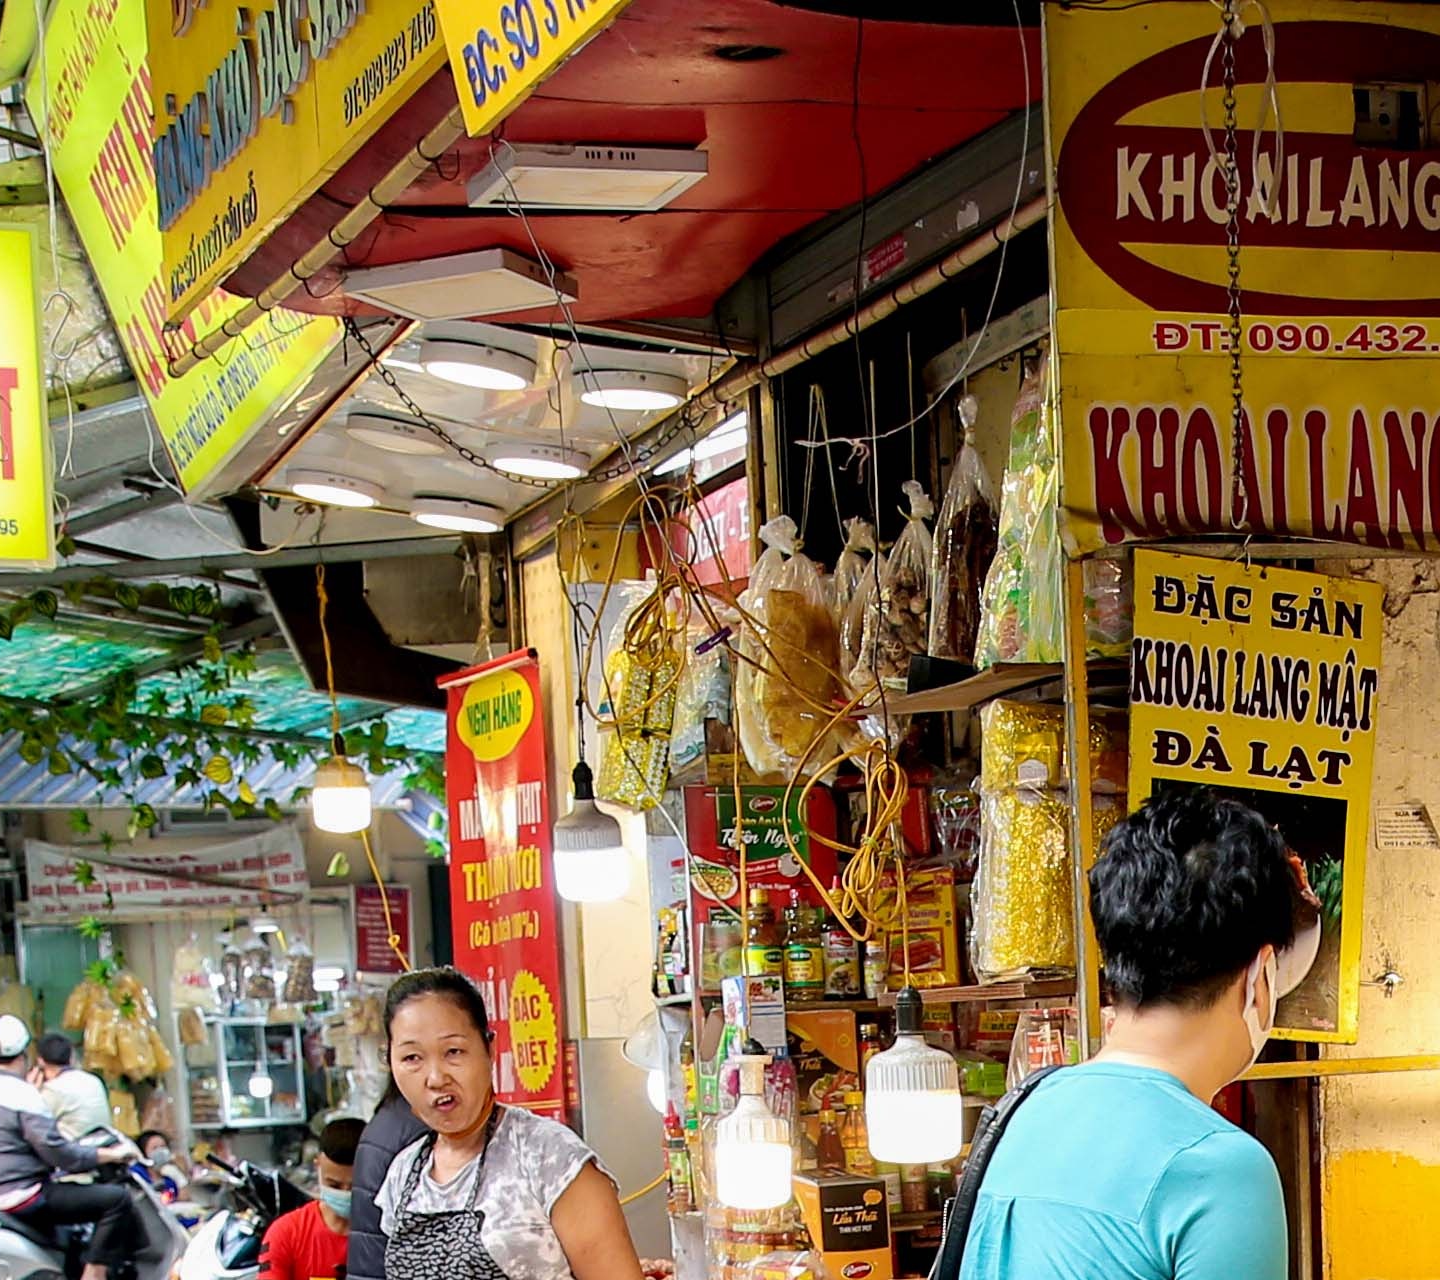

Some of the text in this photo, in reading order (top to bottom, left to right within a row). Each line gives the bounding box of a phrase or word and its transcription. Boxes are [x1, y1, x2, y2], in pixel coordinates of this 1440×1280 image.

[1151, 573, 1364, 640] ĐẶC SẢN
[1131, 638, 1378, 743] KHOAI LANG MẬT
[1151, 725, 1352, 791] ĐÀ LẠT
